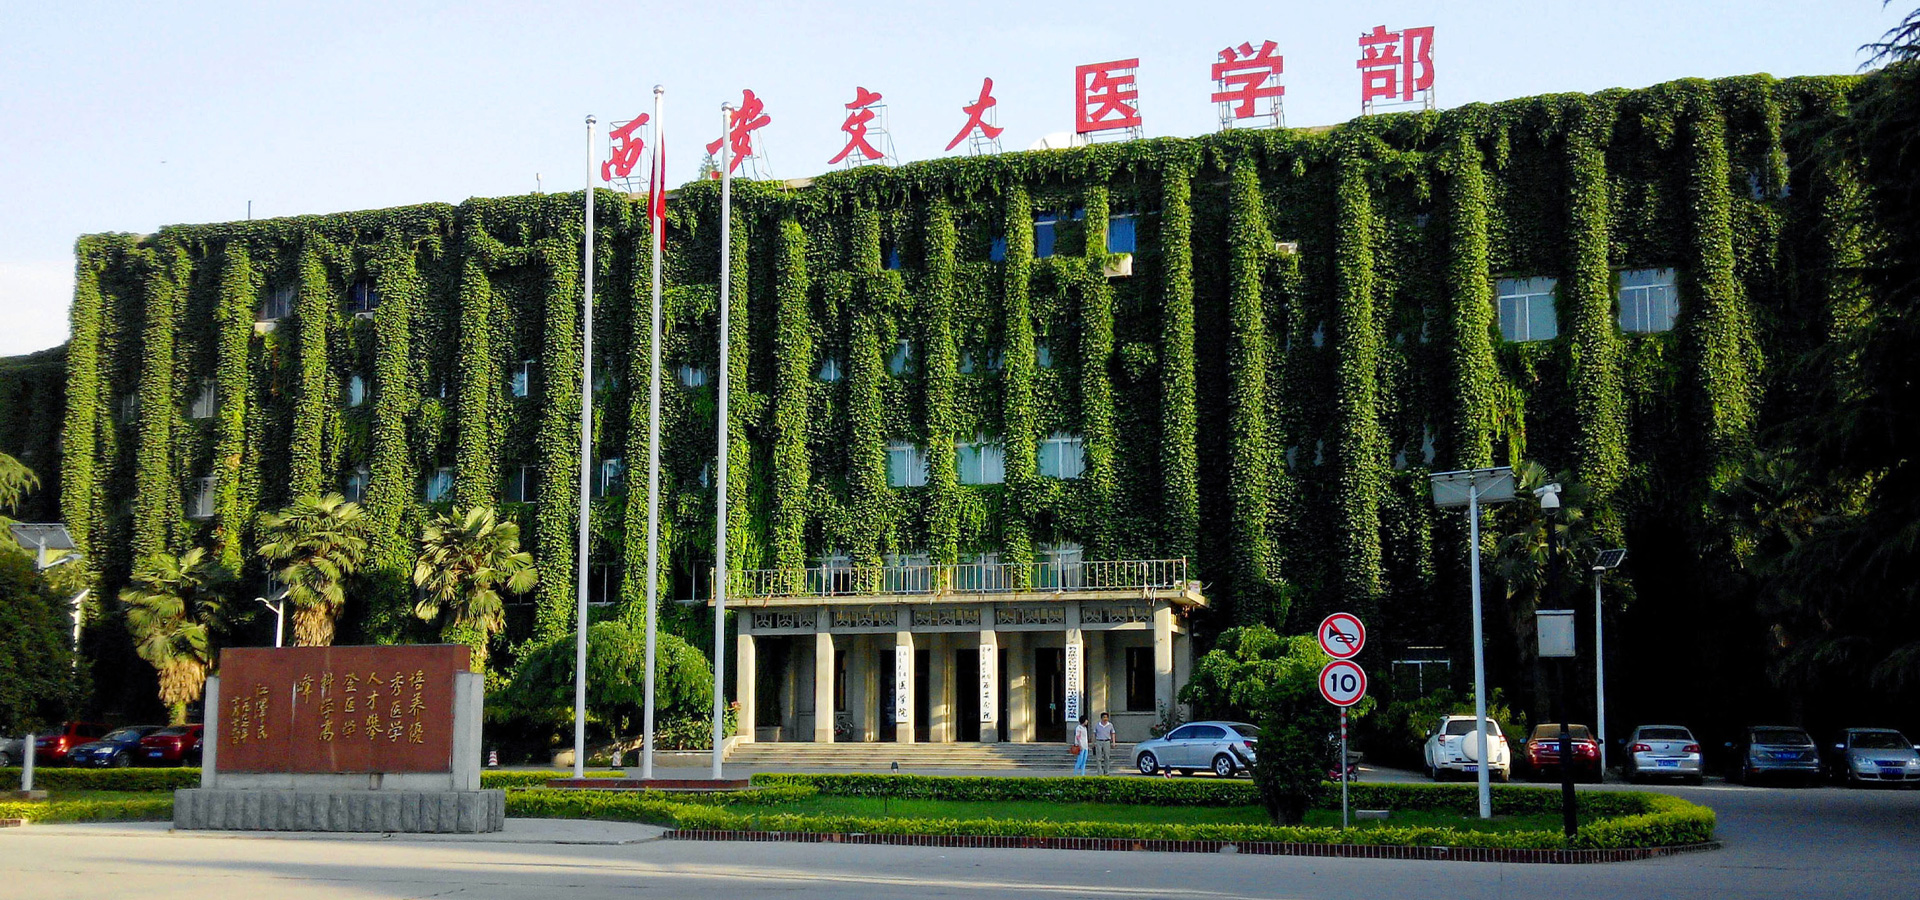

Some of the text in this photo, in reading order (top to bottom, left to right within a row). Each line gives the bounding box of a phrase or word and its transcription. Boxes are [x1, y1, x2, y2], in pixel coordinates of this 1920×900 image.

[601, 25, 1435, 182] 西安交大医学部
[318, 671, 335, 742] 科学高
[365, 671, 384, 741] 人才攀
[1331, 673, 1357, 693] 10
